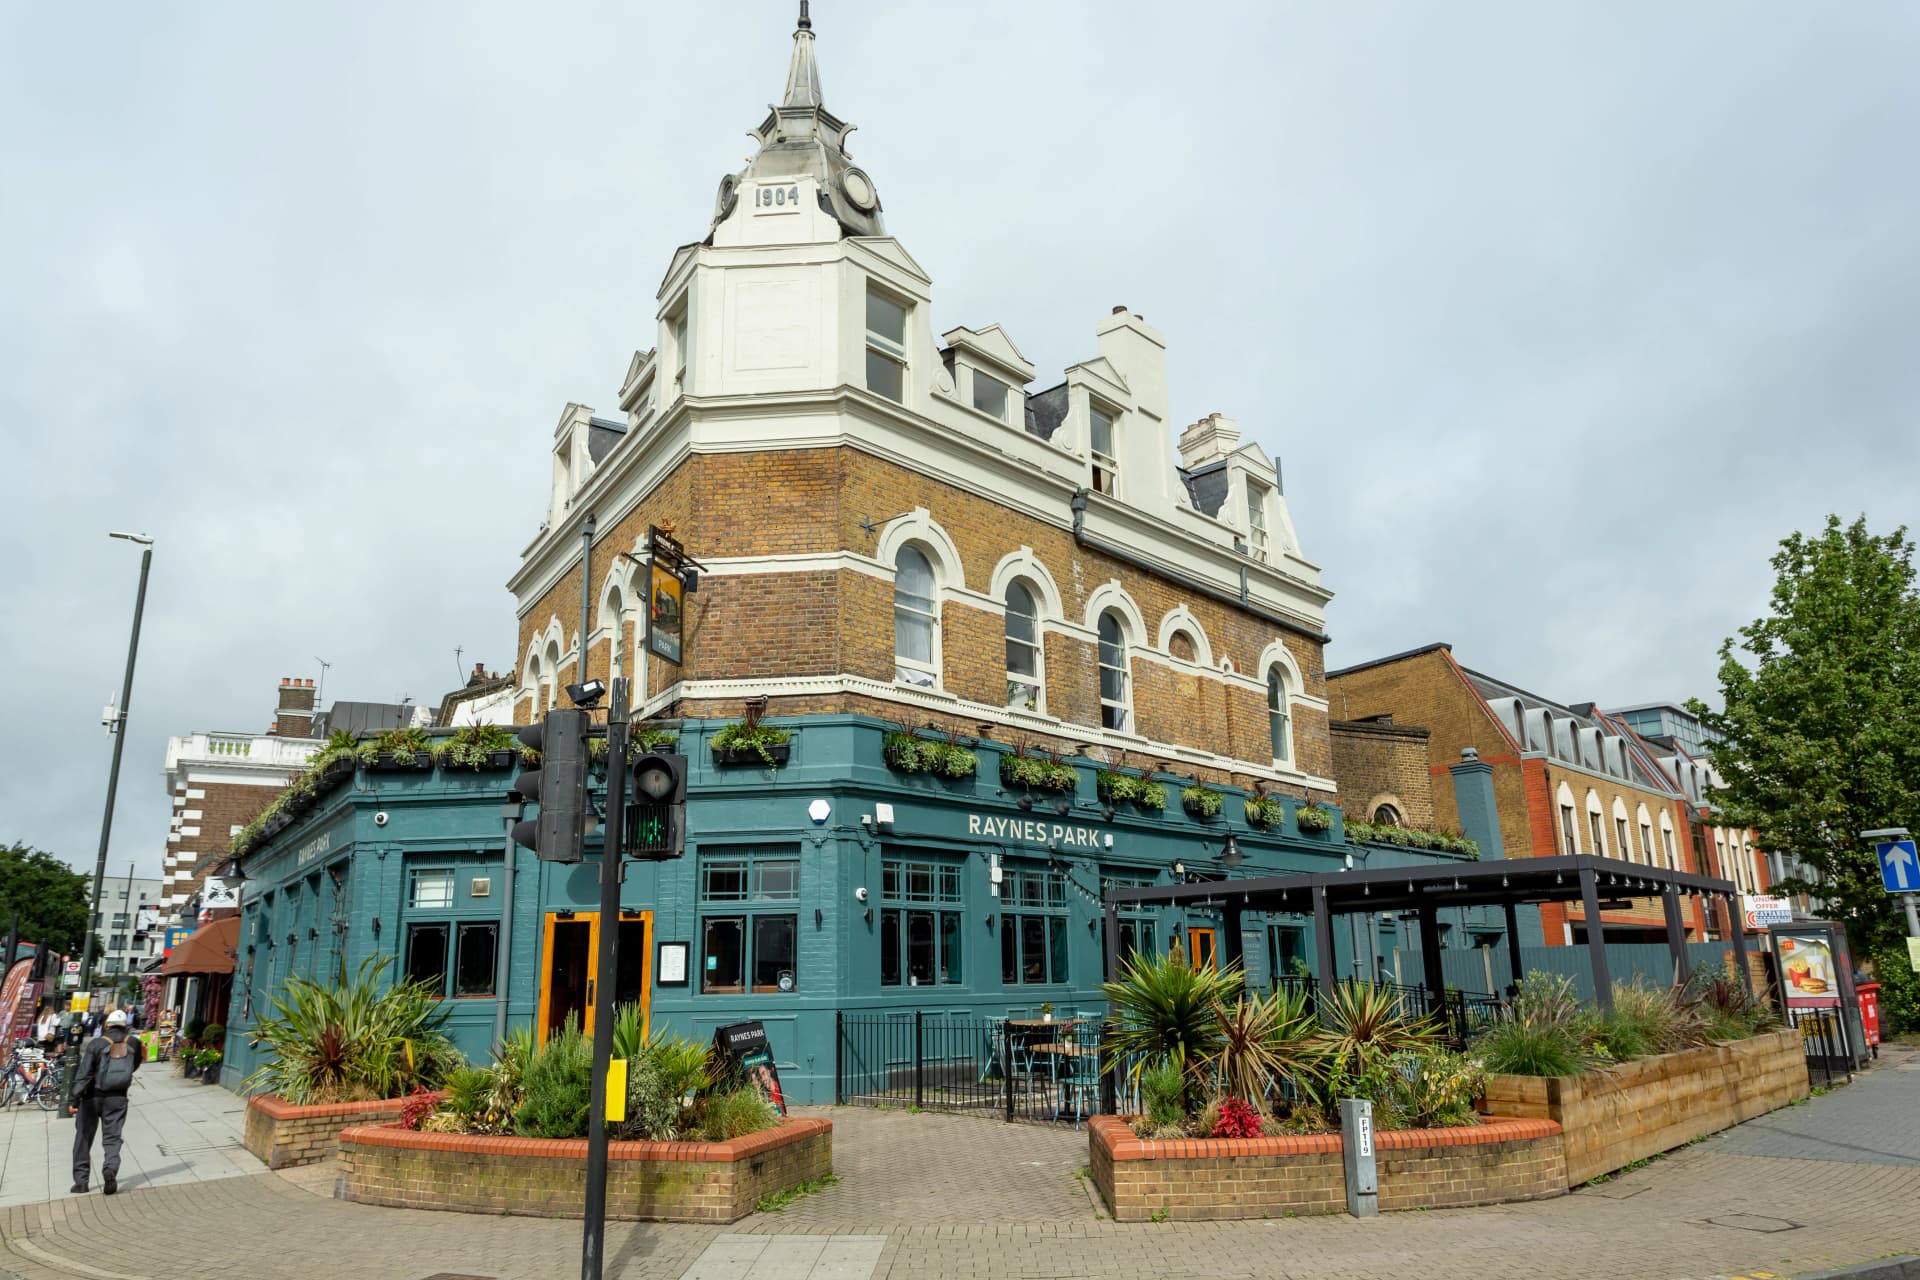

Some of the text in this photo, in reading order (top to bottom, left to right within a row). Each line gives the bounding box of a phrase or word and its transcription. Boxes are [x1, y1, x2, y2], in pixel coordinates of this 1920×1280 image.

[755, 186, 799, 207] 1904
[969, 814, 1100, 848] RAYNES PARK
[730, 1029, 765, 1042] RAYNES PARK
[1361, 1119, 1369, 1153] FP119
